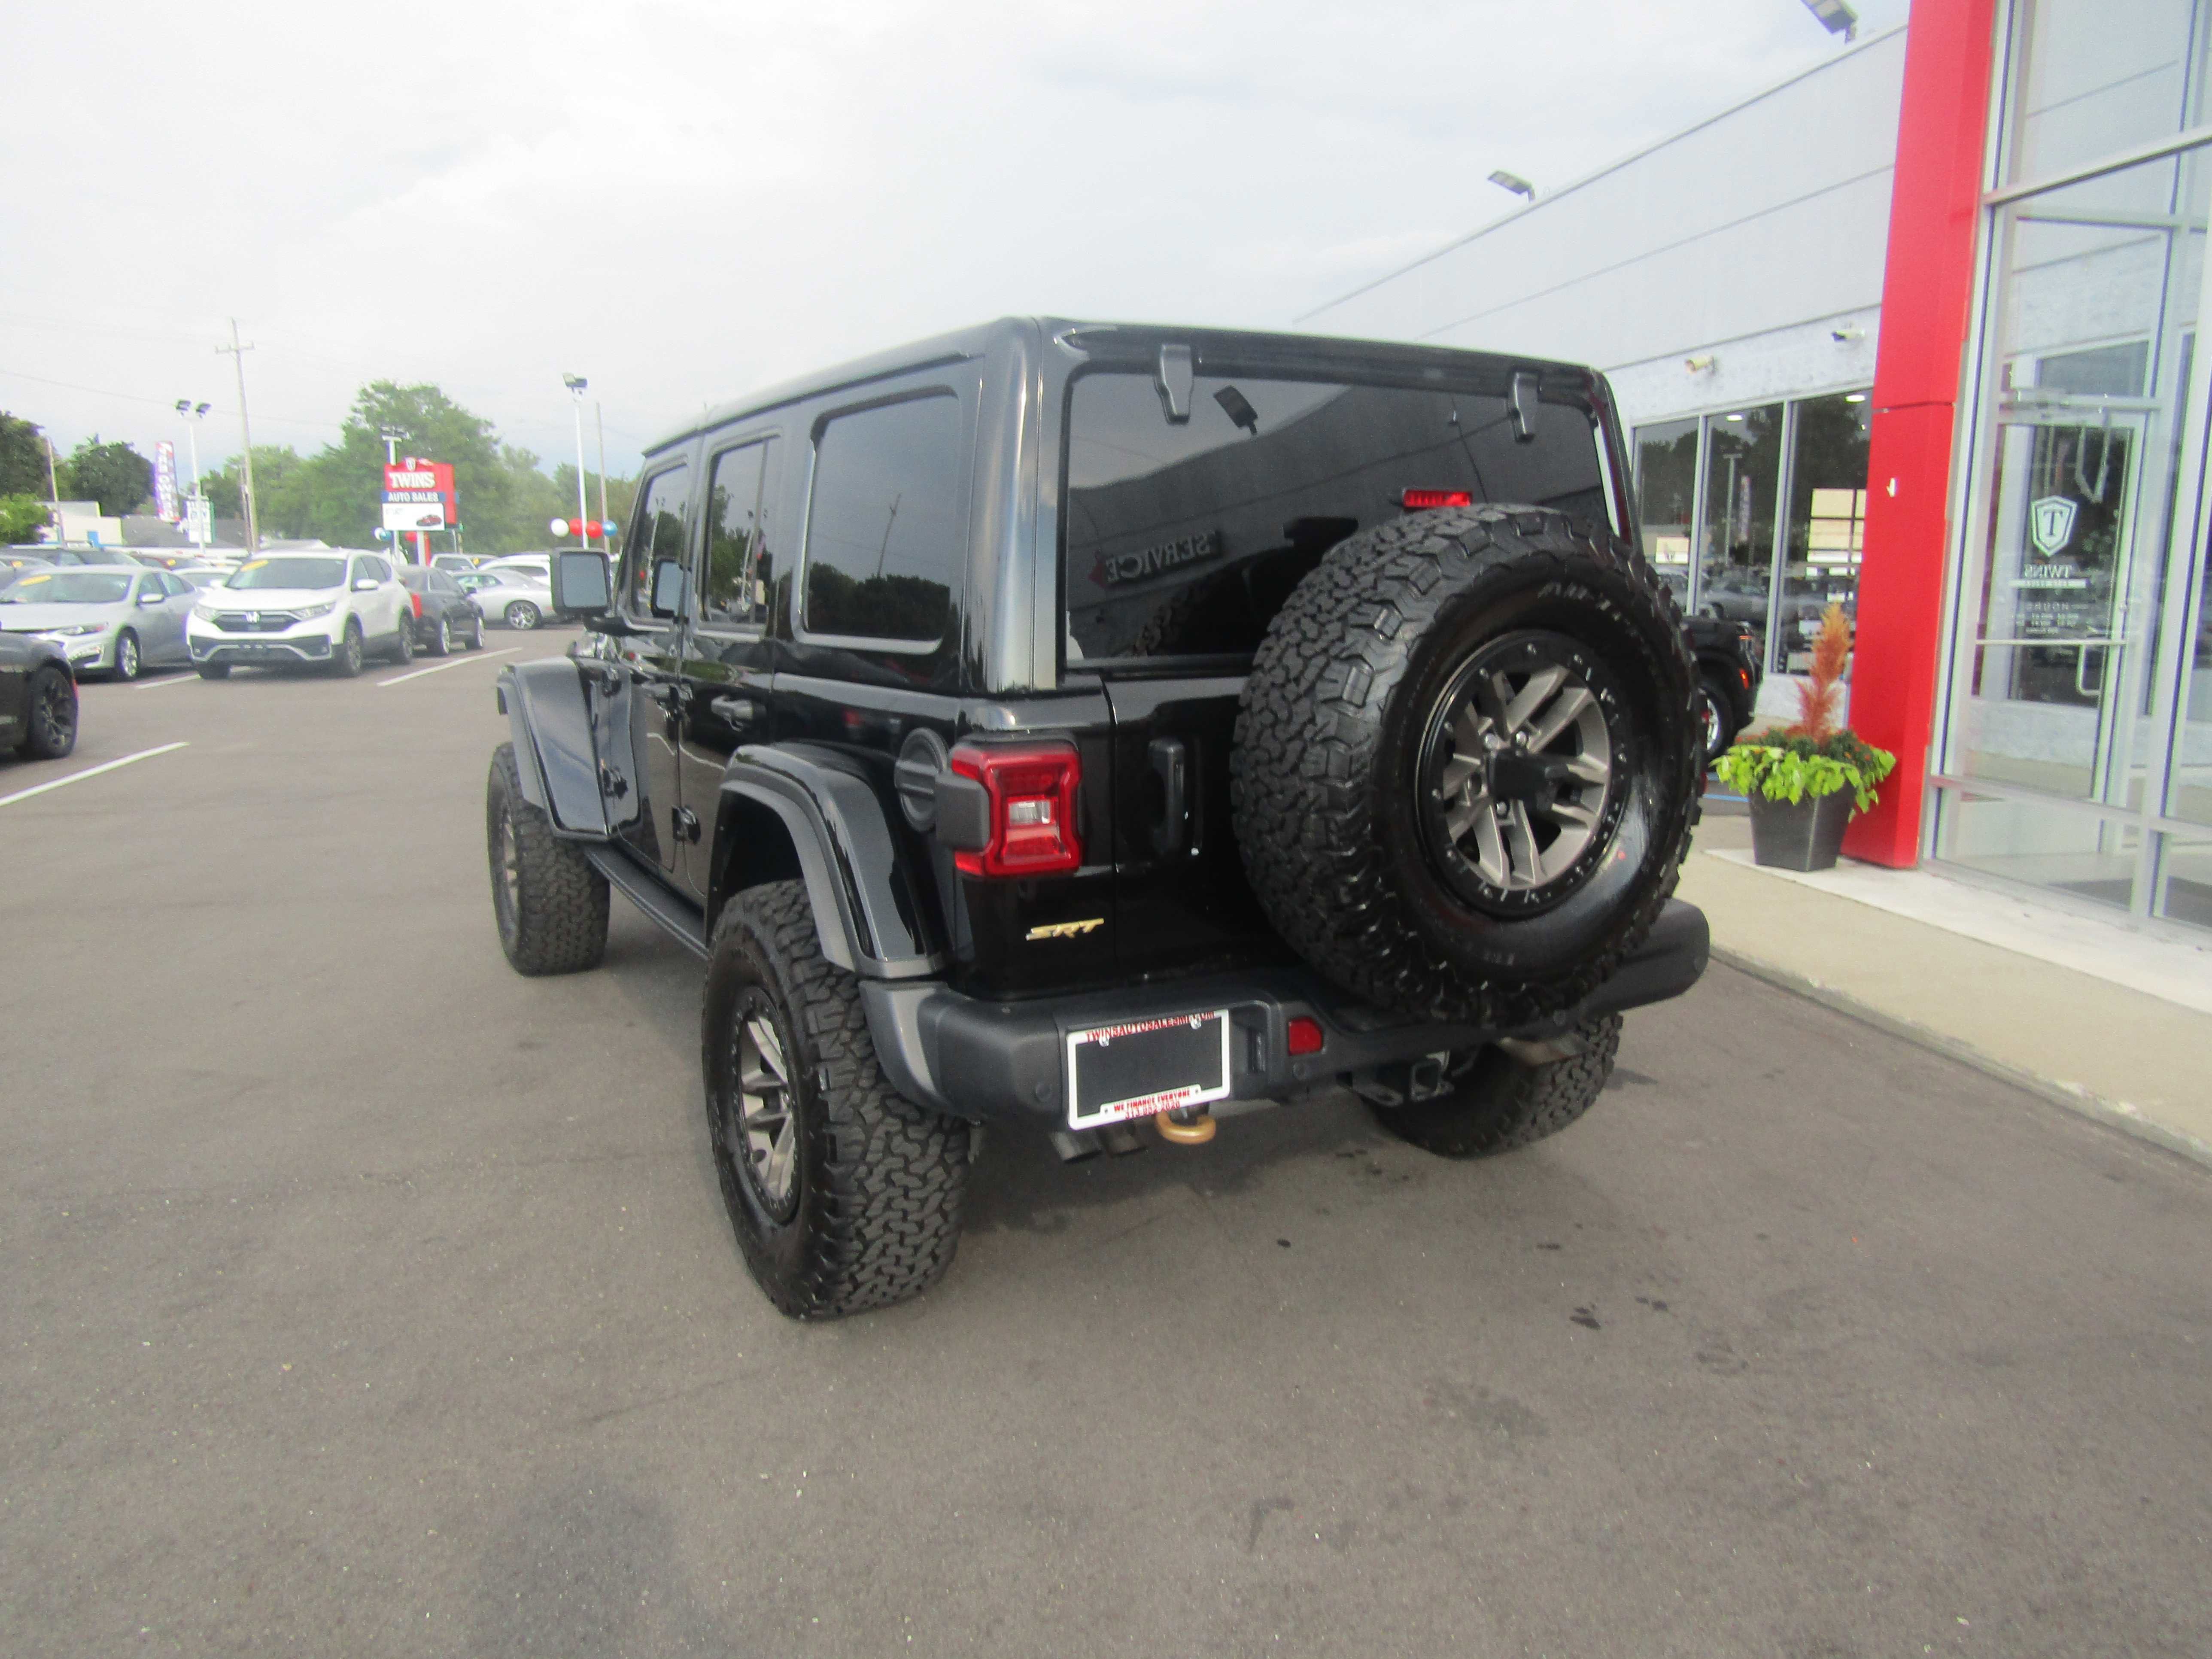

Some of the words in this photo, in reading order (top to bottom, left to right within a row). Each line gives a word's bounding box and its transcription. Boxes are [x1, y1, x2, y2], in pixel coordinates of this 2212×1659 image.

[389, 472, 436, 489] TWINS
[388, 492, 411, 502] AUTO
[412, 492, 439, 502] SALES
[1025, 918, 1105, 941] SRT
[1086, 1010, 1215, 1042] TWINSAUTOSALESMIOM
[1127, 1098, 1155, 1109] FINANCE
[1158, 1090, 1190, 1101] EVERYONE
